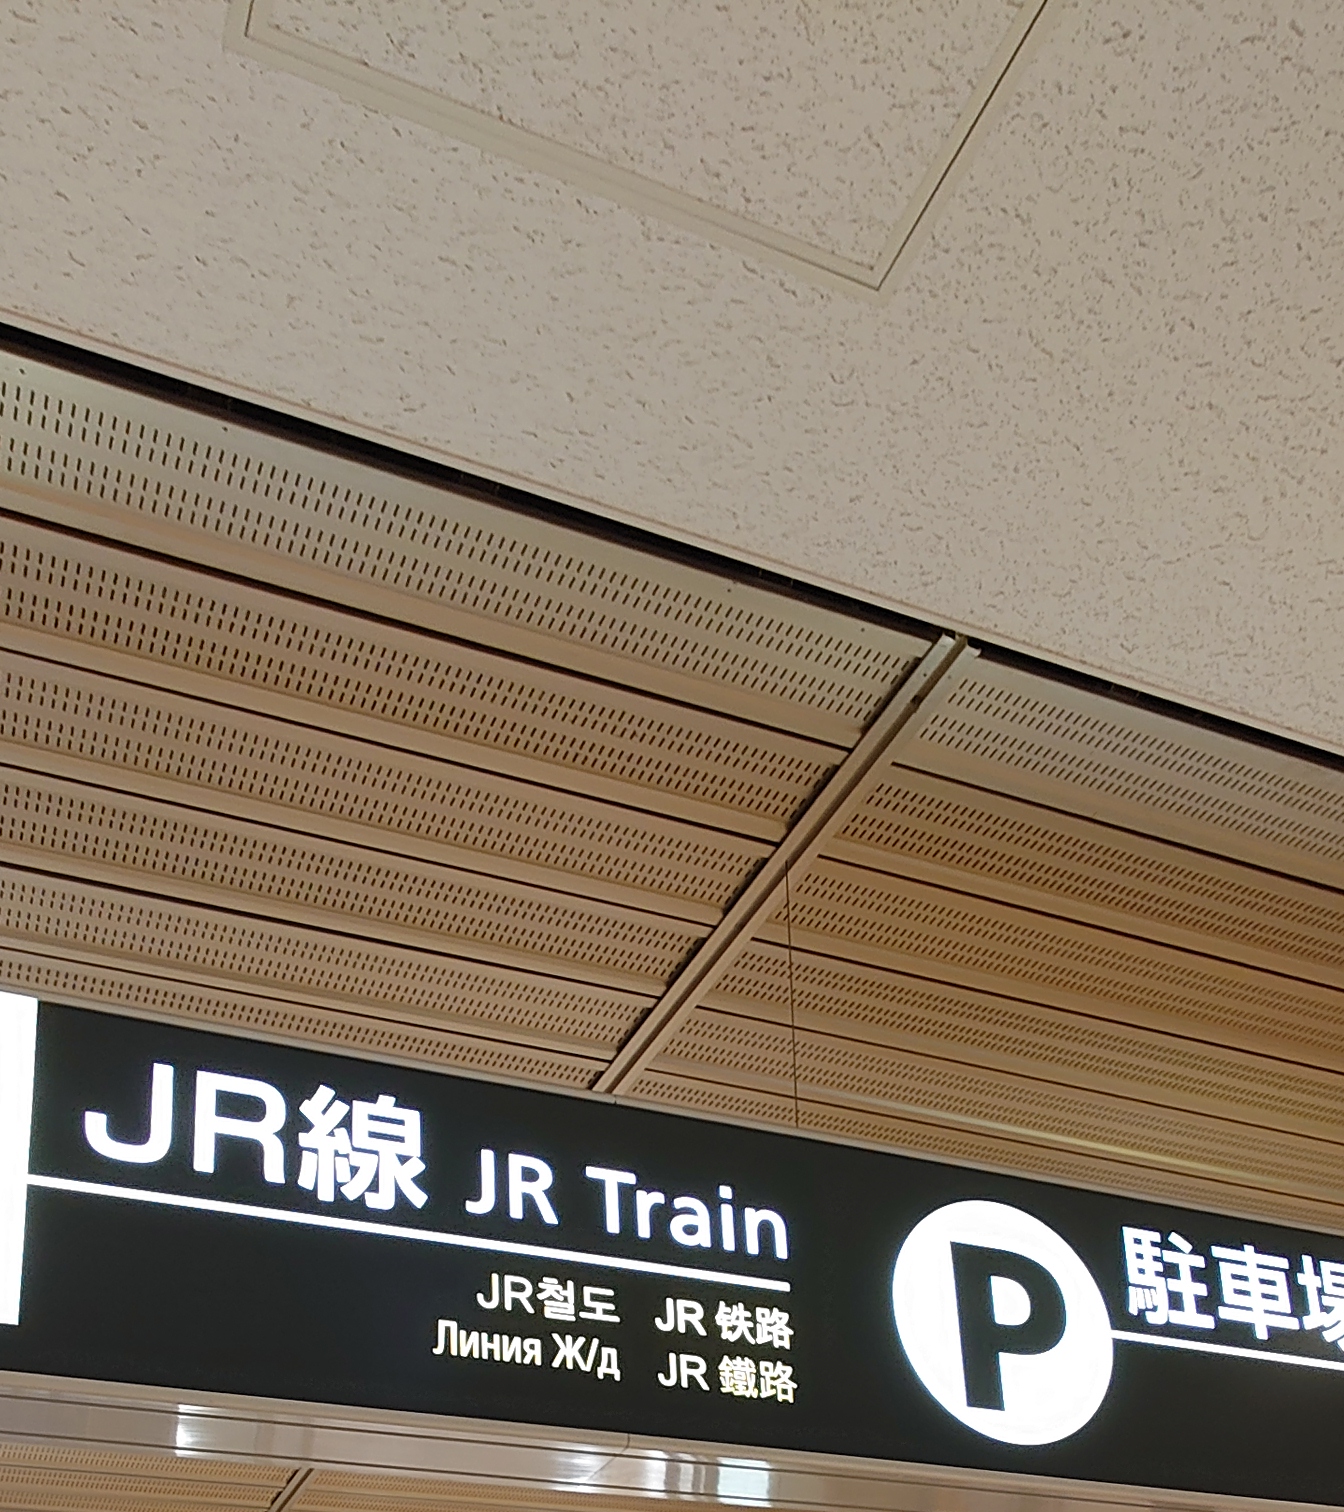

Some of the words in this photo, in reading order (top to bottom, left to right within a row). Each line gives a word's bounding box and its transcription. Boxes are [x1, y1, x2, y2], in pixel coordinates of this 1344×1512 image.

[84, 1062, 429, 1212] JR線
[465, 1149, 560, 1226] JR
[585, 1165, 790, 1260] Train
[475, 1272, 621, 1325] JR철도
[655, 1297, 707, 1338] JR
[714, 1300, 795, 1351] 铁路
[949, 1241, 1068, 1412] P
[432, 1319, 543, 1368] Линия
[551, 1332, 622, 1383] Ж/д
[657, 1352, 710, 1393] JR
[718, 1355, 799, 1405] 鐵路
